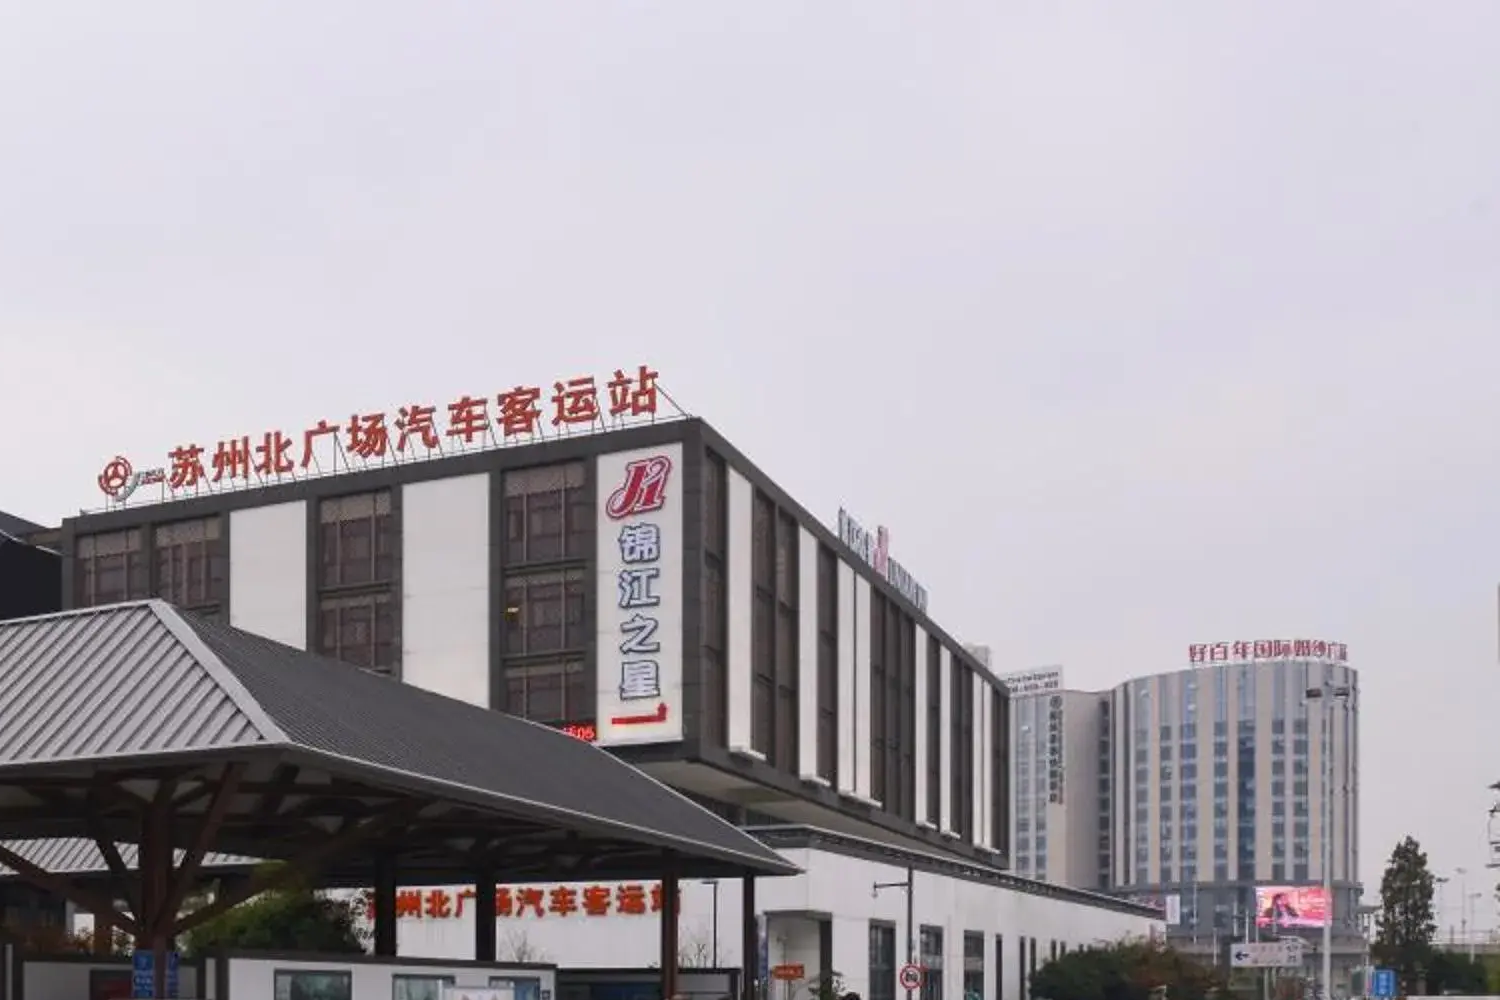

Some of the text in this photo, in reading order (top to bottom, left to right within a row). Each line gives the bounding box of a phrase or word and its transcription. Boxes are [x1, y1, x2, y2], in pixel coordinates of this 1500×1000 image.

[168, 366, 658, 488] 苏州北广场汽车客运站
[618, 522, 661, 700] 锦江之星
